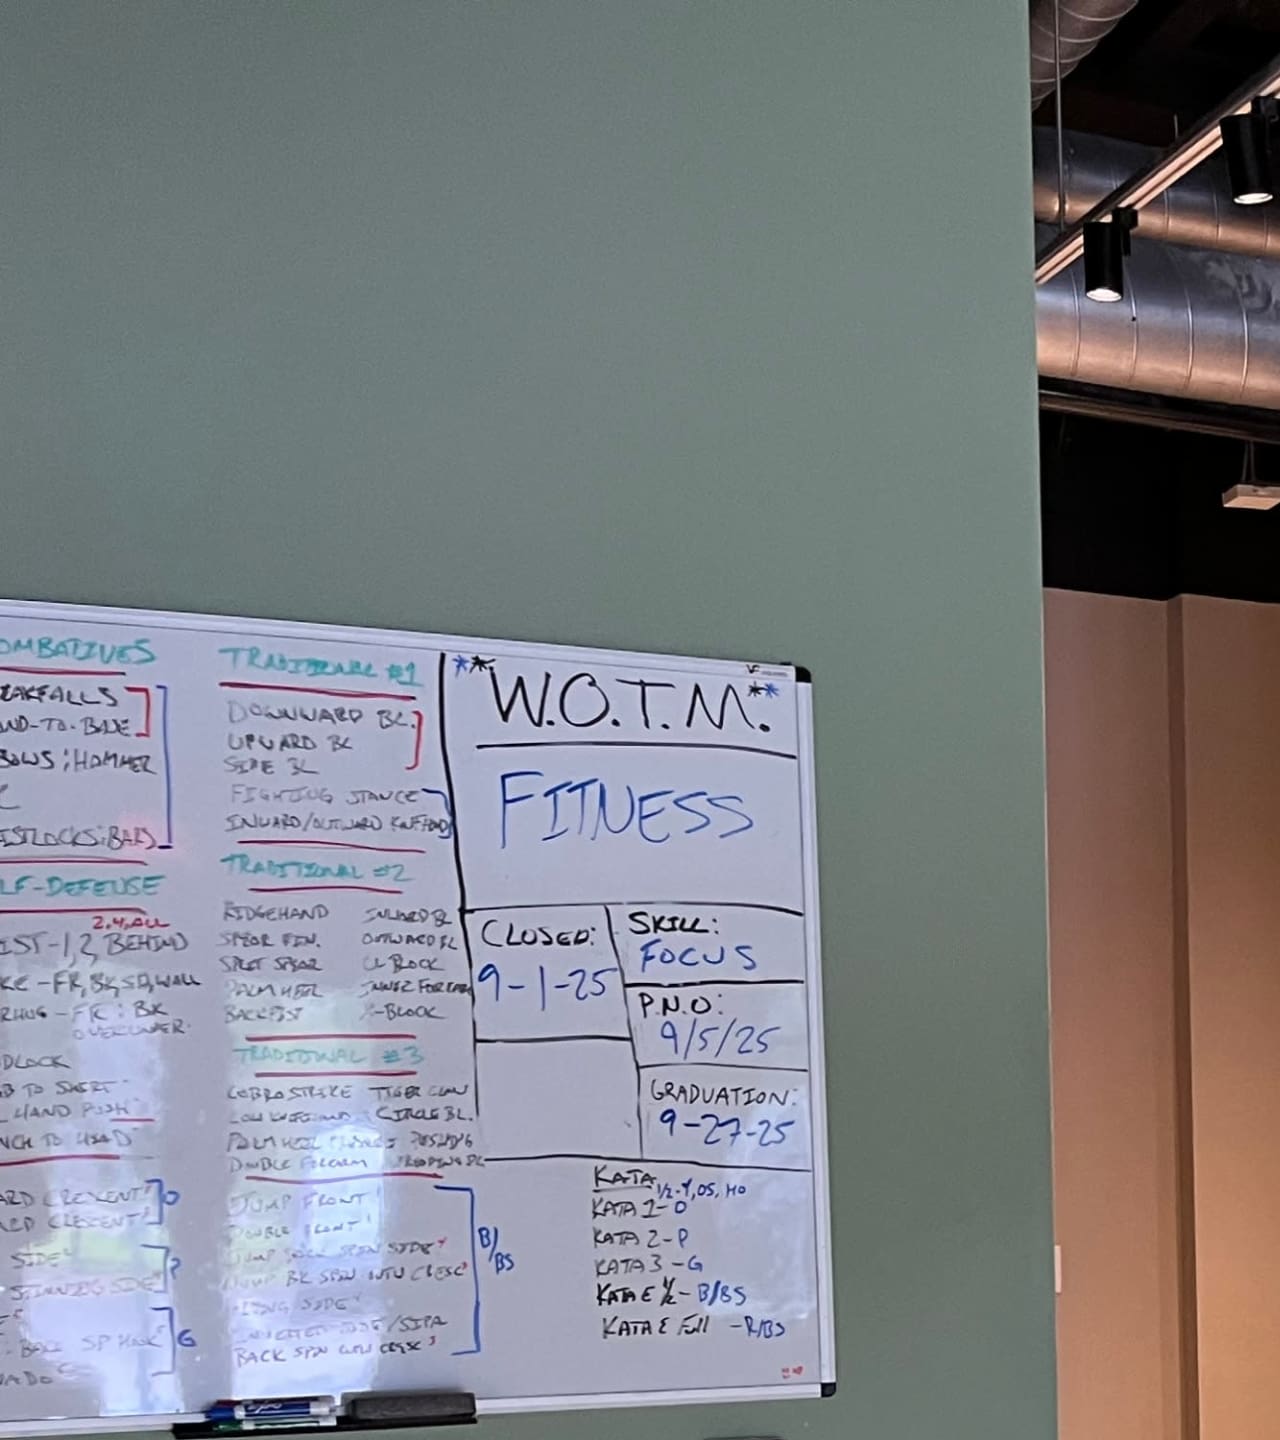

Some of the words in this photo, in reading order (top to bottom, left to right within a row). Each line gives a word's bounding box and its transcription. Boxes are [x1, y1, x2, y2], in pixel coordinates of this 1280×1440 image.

[500, 770, 755, 850] FITNESS
[628, 911, 720, 937] SKILL:
[640, 938, 758, 973] FOCUS
[477, 962, 618, 1012] 9-1-25
[661, 1017, 782, 1060] 9/5/25
[649, 1079, 799, 1107] GRADUATION:
[660, 1108, 796, 1148] 9-27-25
[593, 1197, 638, 1219] KATA
[593, 1226, 640, 1249] KATA
[594, 1258, 646, 1279] KATA
[596, 1283, 636, 1307] KATA
[602, 1315, 652, 1340] KATA
